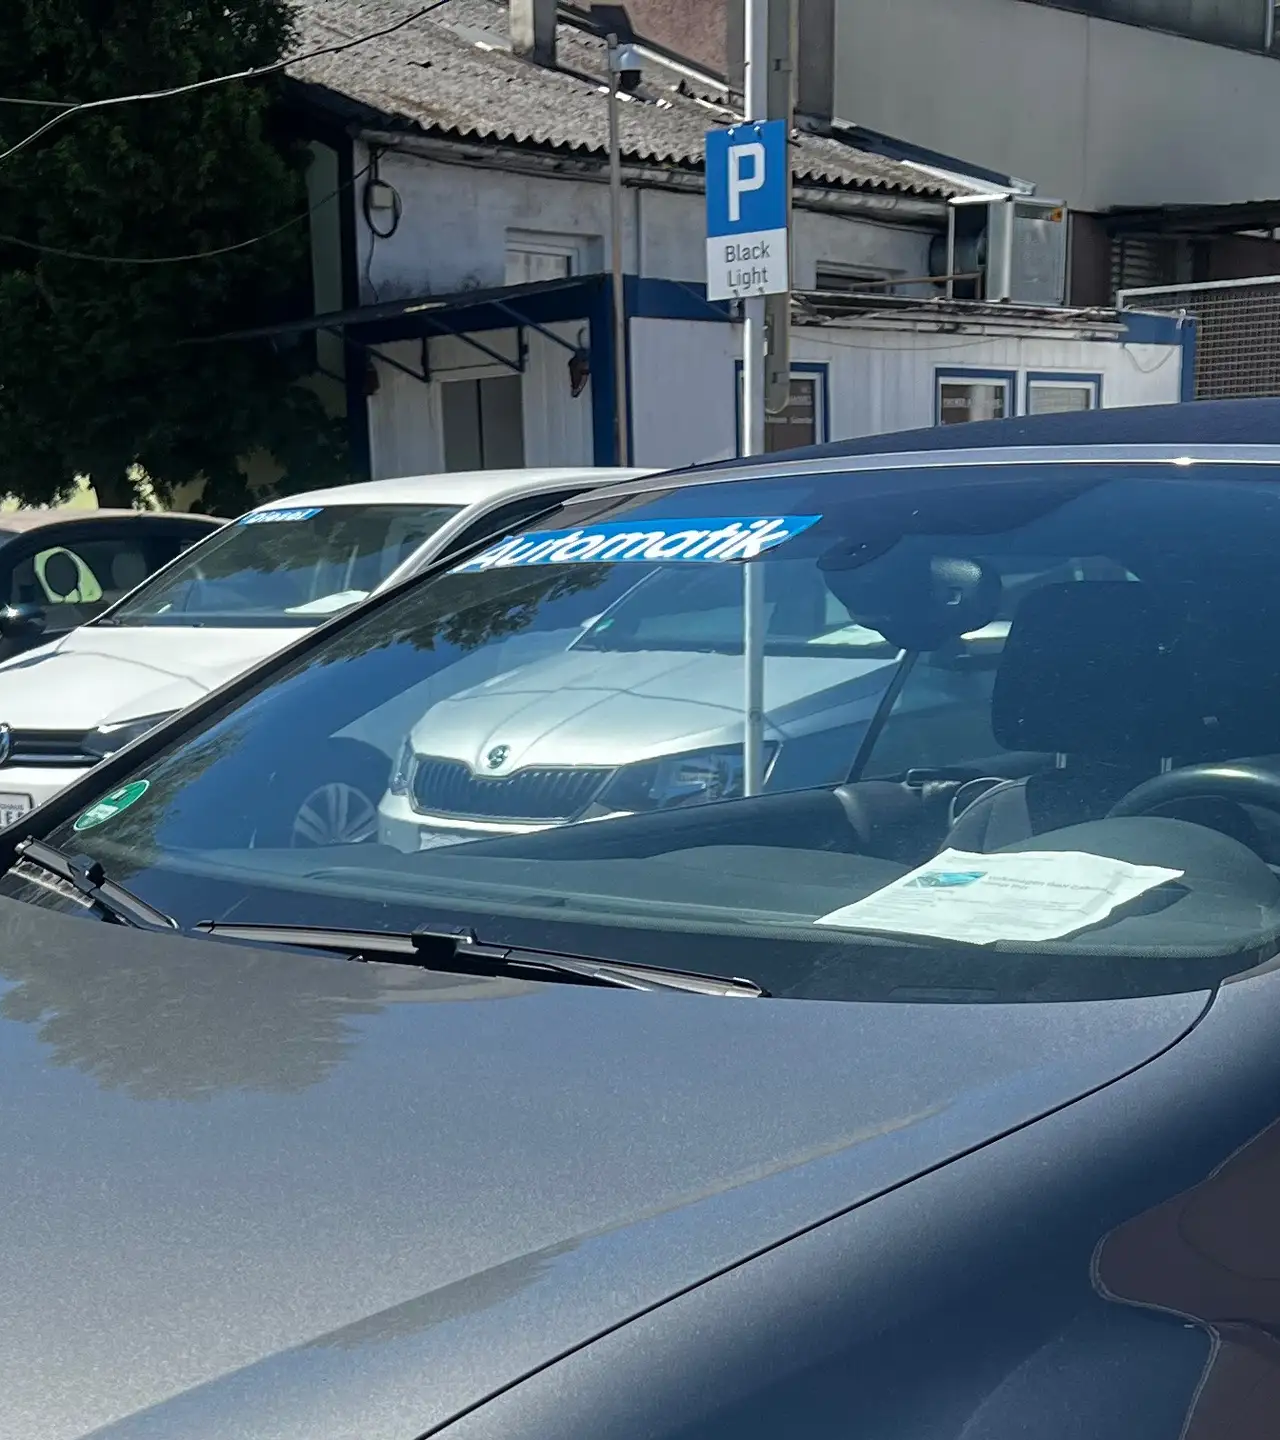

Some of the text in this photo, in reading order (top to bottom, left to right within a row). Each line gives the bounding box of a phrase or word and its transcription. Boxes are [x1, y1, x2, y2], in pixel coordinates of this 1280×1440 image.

[728, 142, 766, 222] P
[725, 240, 771, 263] Black
[728, 266, 769, 291] Light
[448, 519, 789, 573] Automatik
